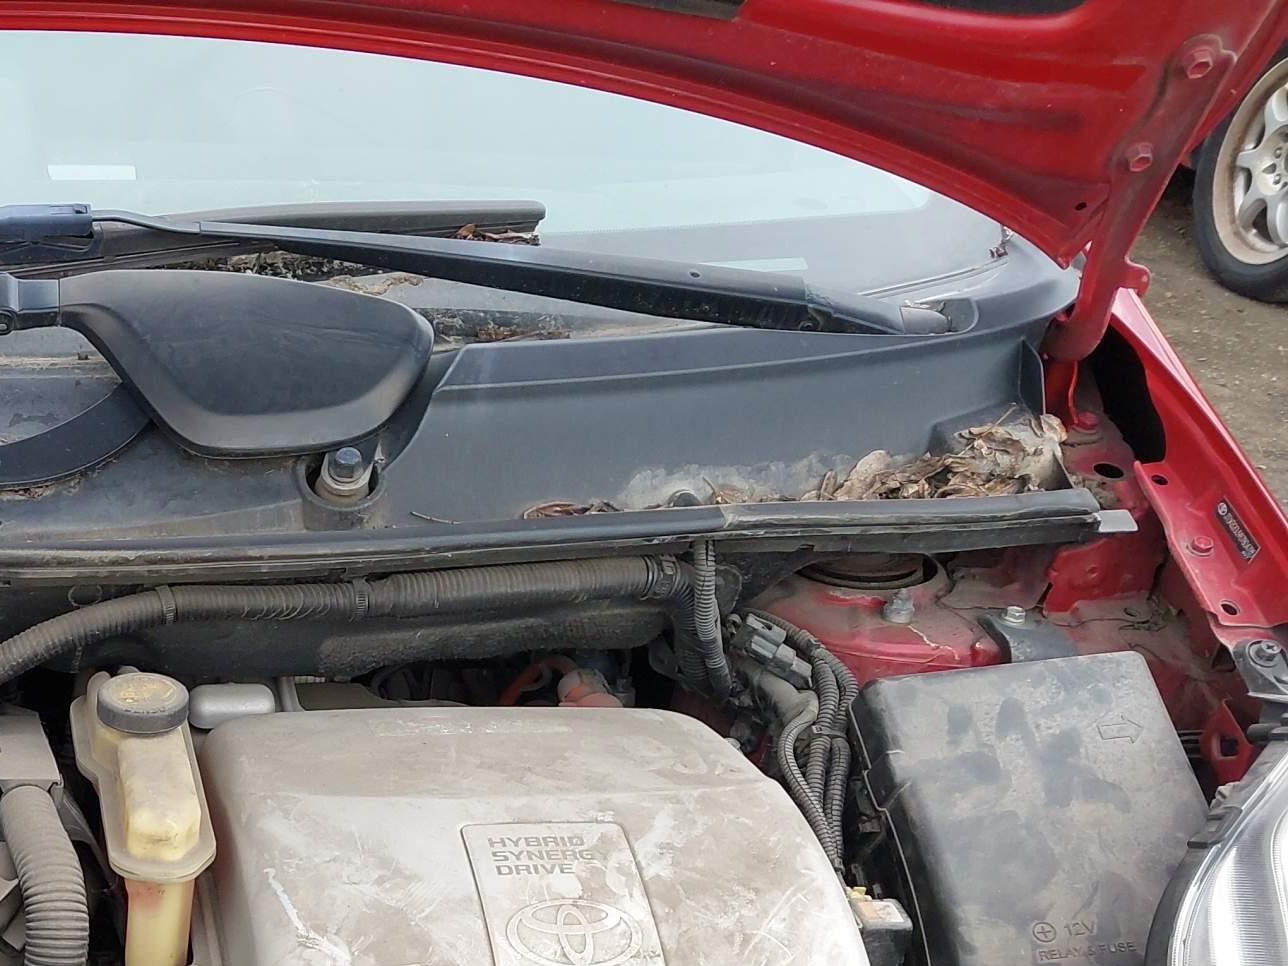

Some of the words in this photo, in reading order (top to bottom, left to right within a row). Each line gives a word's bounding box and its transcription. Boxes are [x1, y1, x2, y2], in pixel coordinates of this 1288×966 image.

[488, 836, 585, 848] HYBRID
[491, 849, 598, 862] SYNERG
[496, 863, 576, 876] DRIVE
[1064, 920, 1096, 936] 12V
[1038, 946, 1082, 961] RELAY
[1097, 941, 1137, 954] FUSE
